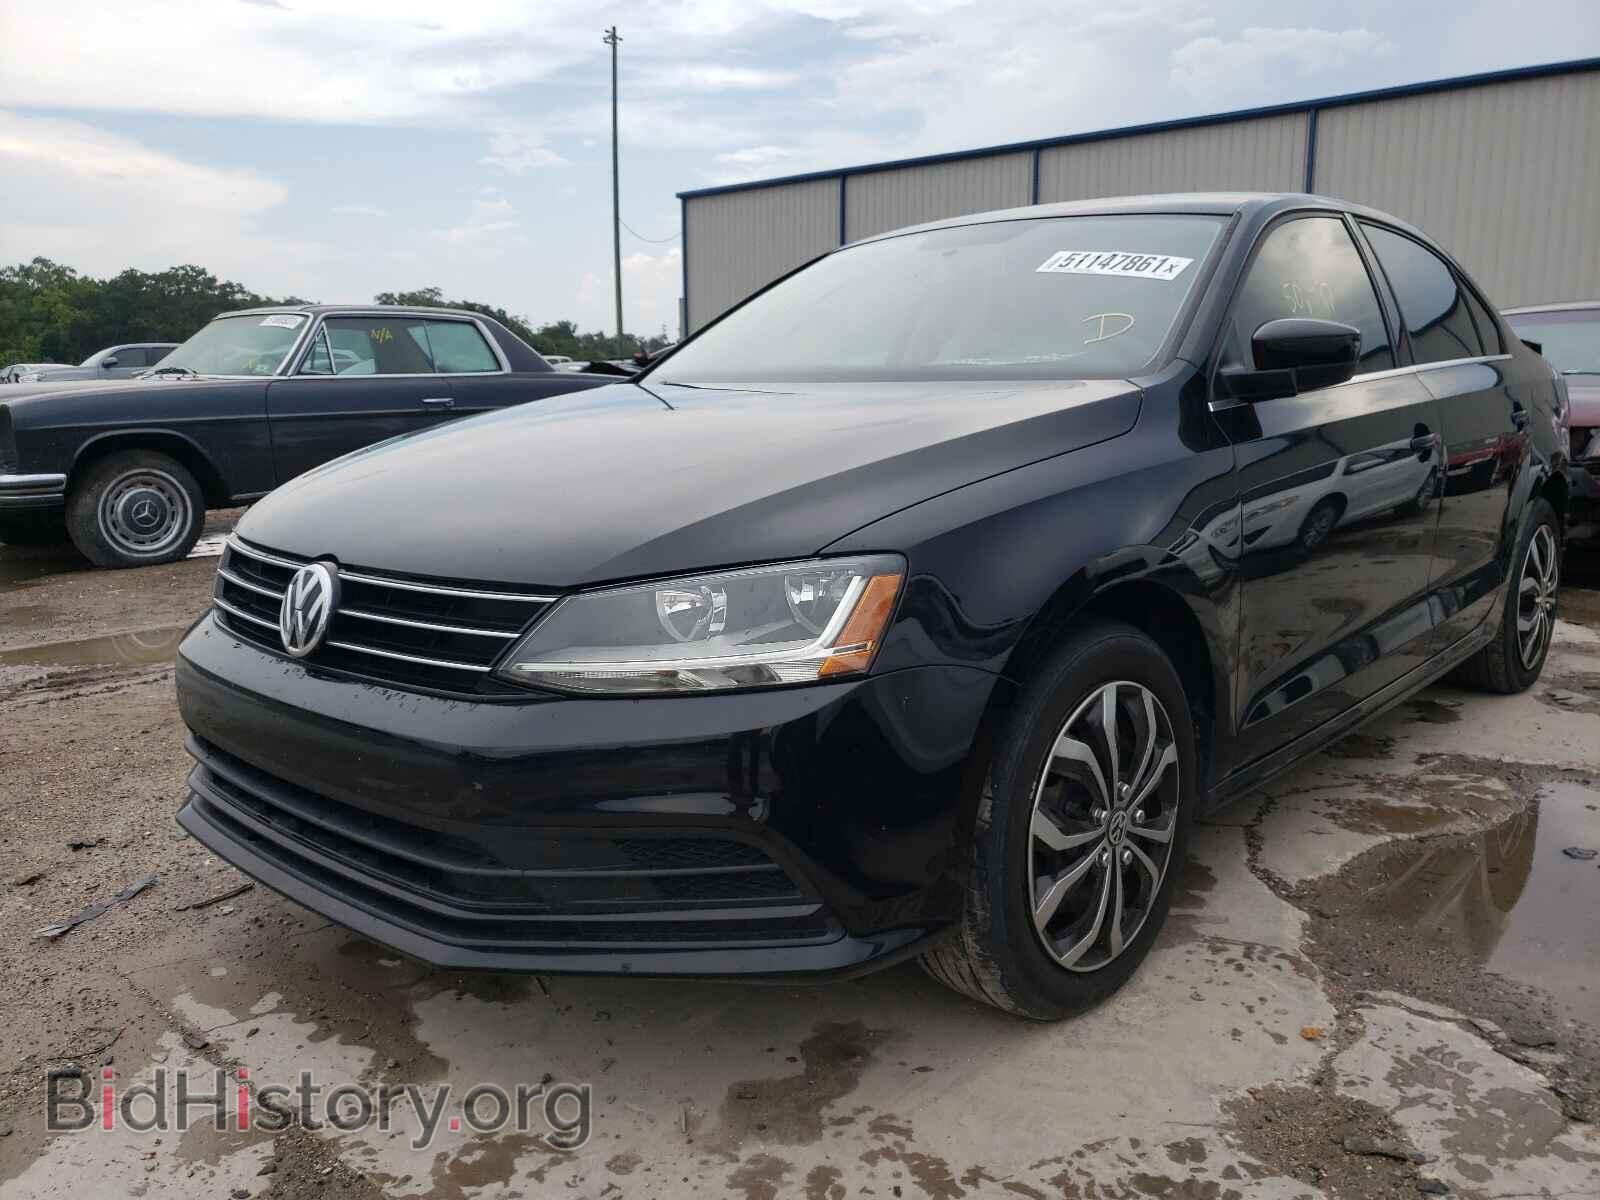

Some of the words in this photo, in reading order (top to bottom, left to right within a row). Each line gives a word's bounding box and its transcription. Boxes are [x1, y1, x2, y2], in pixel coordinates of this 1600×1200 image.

[370, 328, 393, 345] N/A
[1081, 312, 1136, 344] D
[280, 563, 333, 657] VW
